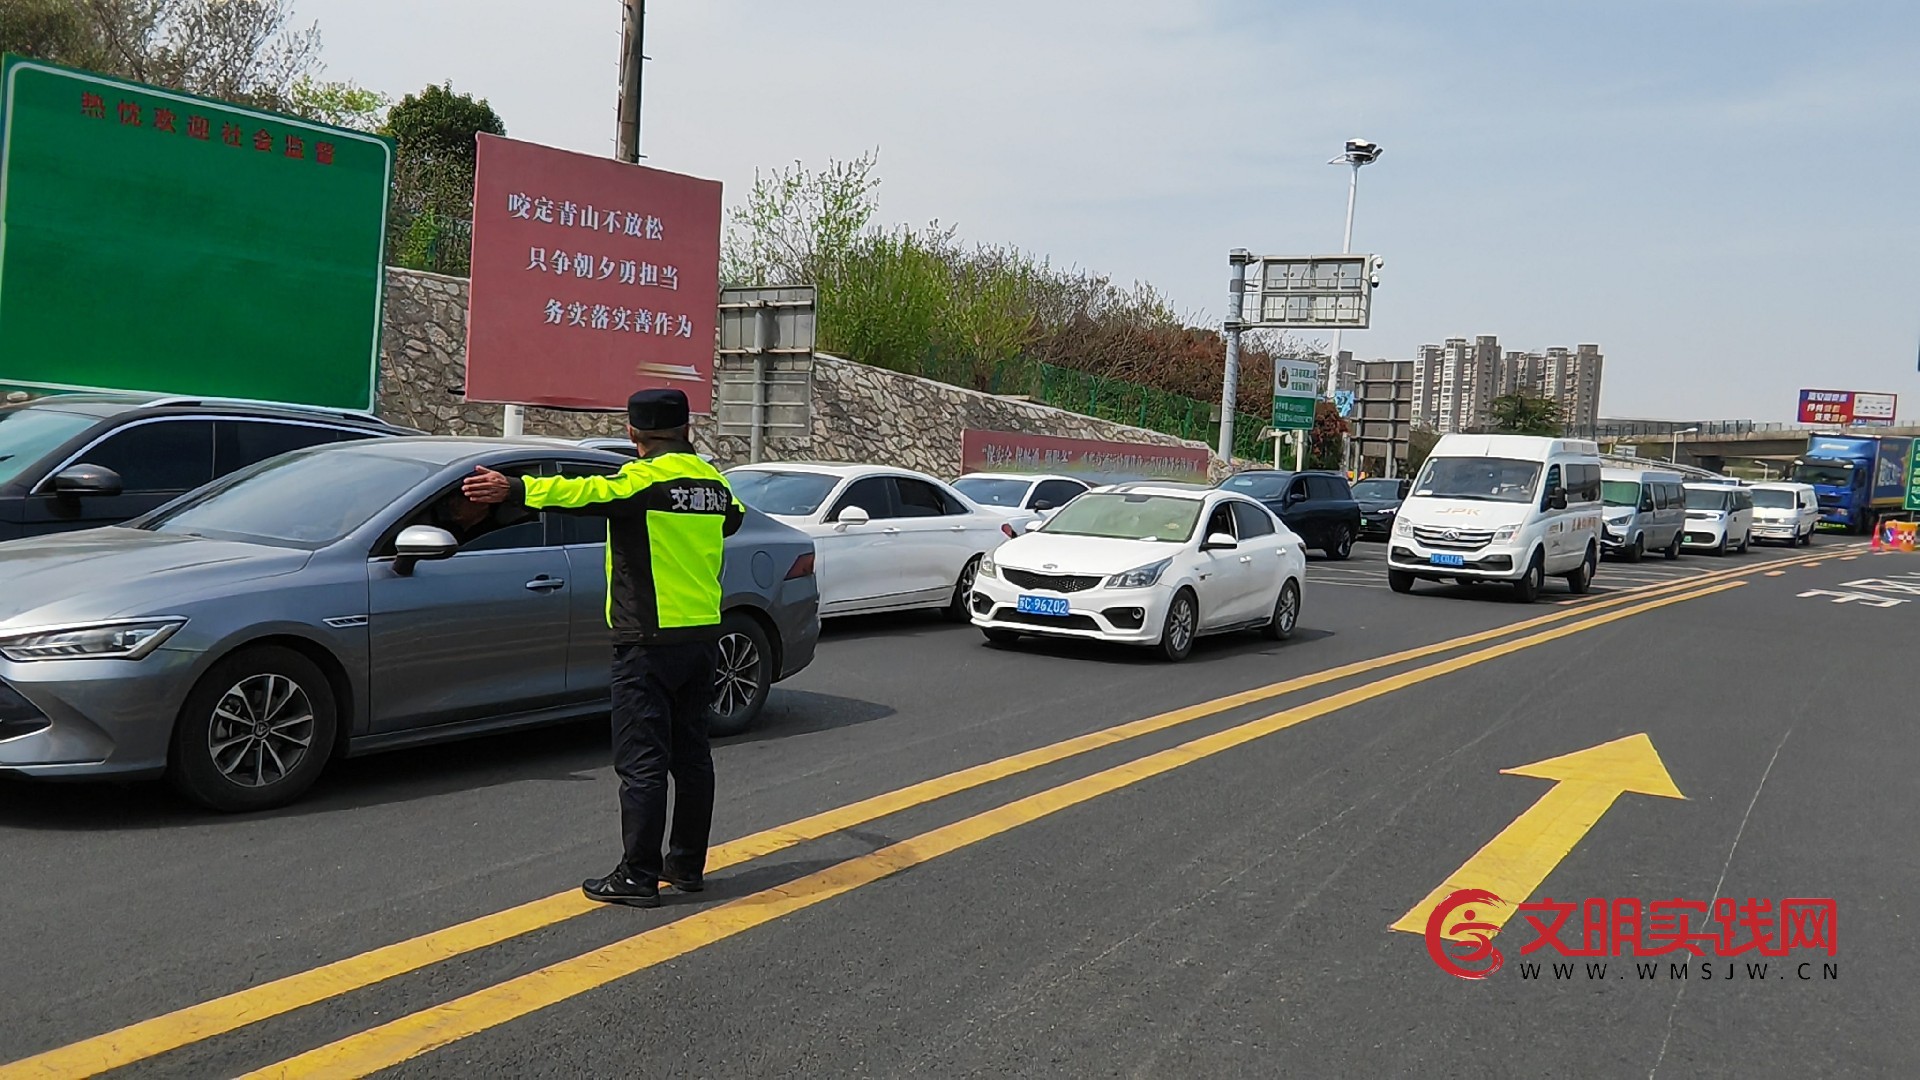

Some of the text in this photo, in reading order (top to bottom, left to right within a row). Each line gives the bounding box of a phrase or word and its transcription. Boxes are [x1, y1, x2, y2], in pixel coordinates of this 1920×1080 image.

[81, 91, 336, 165] 热忱欢迎社会监督
[508, 192, 664, 242] 咬定青山不放松
[526, 246, 679, 291] 只争朝夕勇担当
[543, 298, 693, 339] 务实落实善作为
